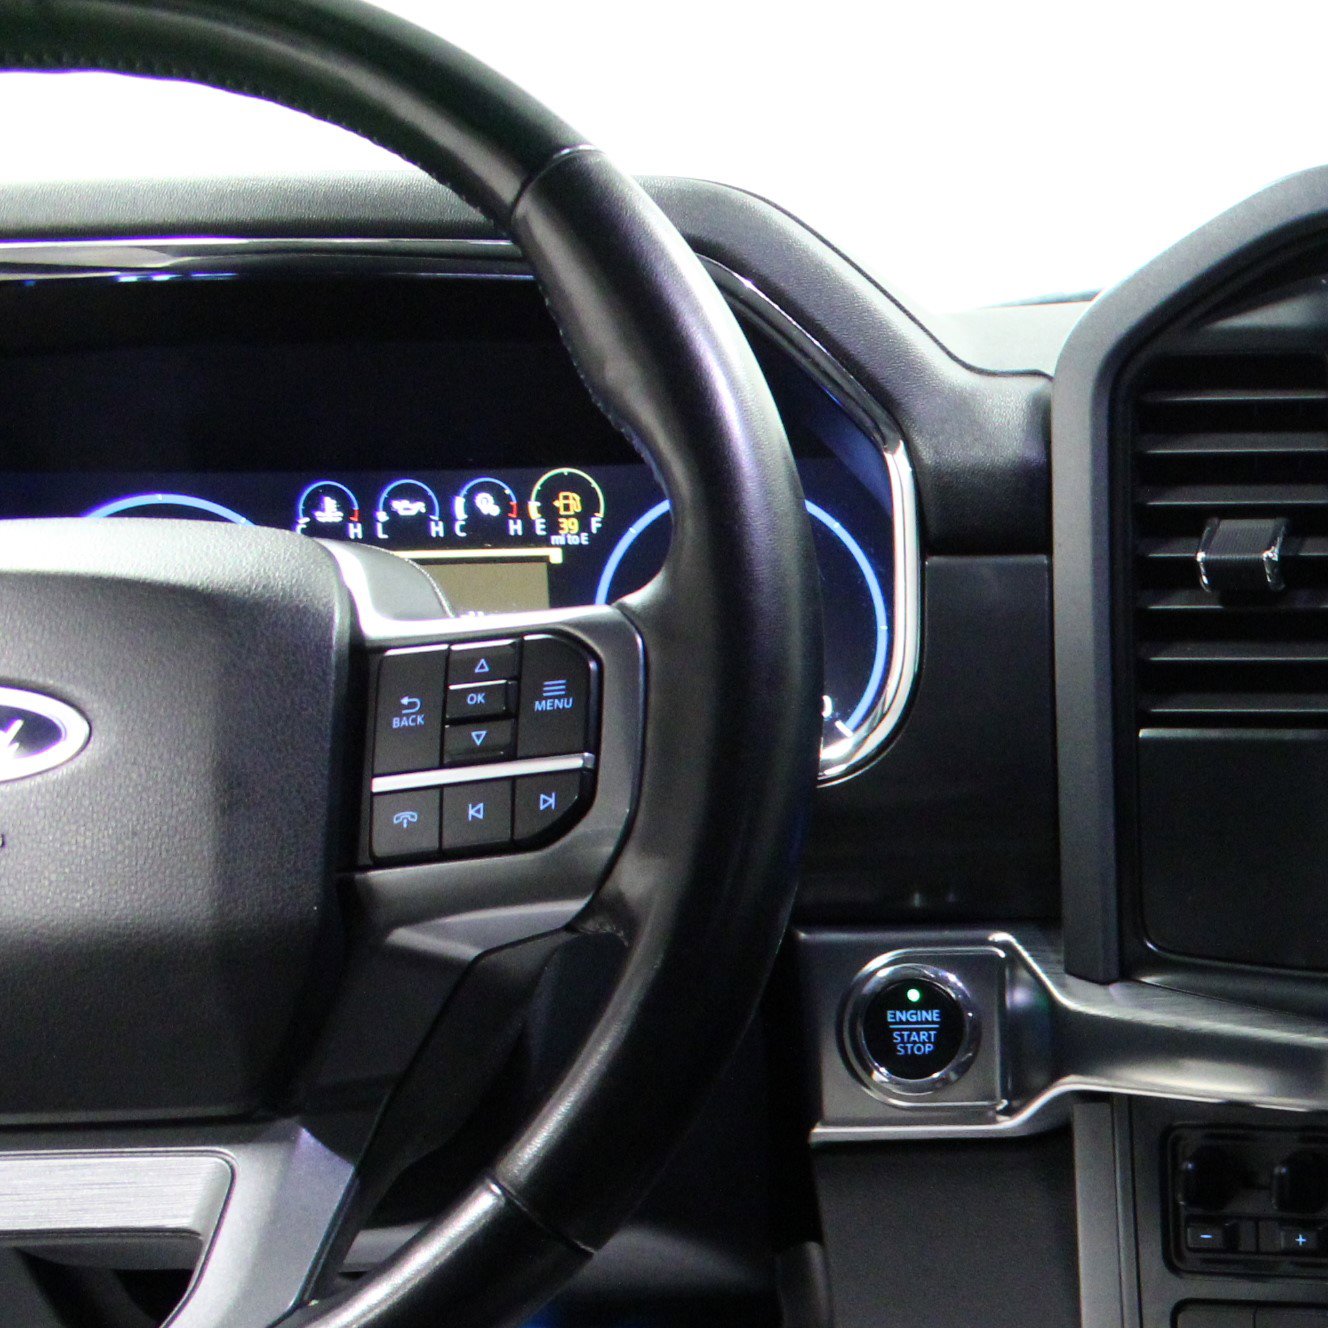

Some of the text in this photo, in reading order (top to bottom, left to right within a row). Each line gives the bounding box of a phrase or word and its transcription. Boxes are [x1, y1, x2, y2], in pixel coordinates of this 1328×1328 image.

[348, 522, 363, 539] H
[376, 520, 389, 538] L
[430, 519, 445, 537] H
[454, 519, 467, 537] C
[508, 518, 523, 536] H
[534, 518, 547, 535] E
[557, 517, 579, 534] 39
[590, 516, 603, 534] F
[580, 532, 589, 545] E
[466, 693, 486, 705] OK
[534, 698, 573, 712] MENU
[392, 714, 425, 729] BACK
[886, 1010, 941, 1022] ENGINE
[893, 1031, 937, 1043] START
[896, 1044, 934, 1055] STOP
